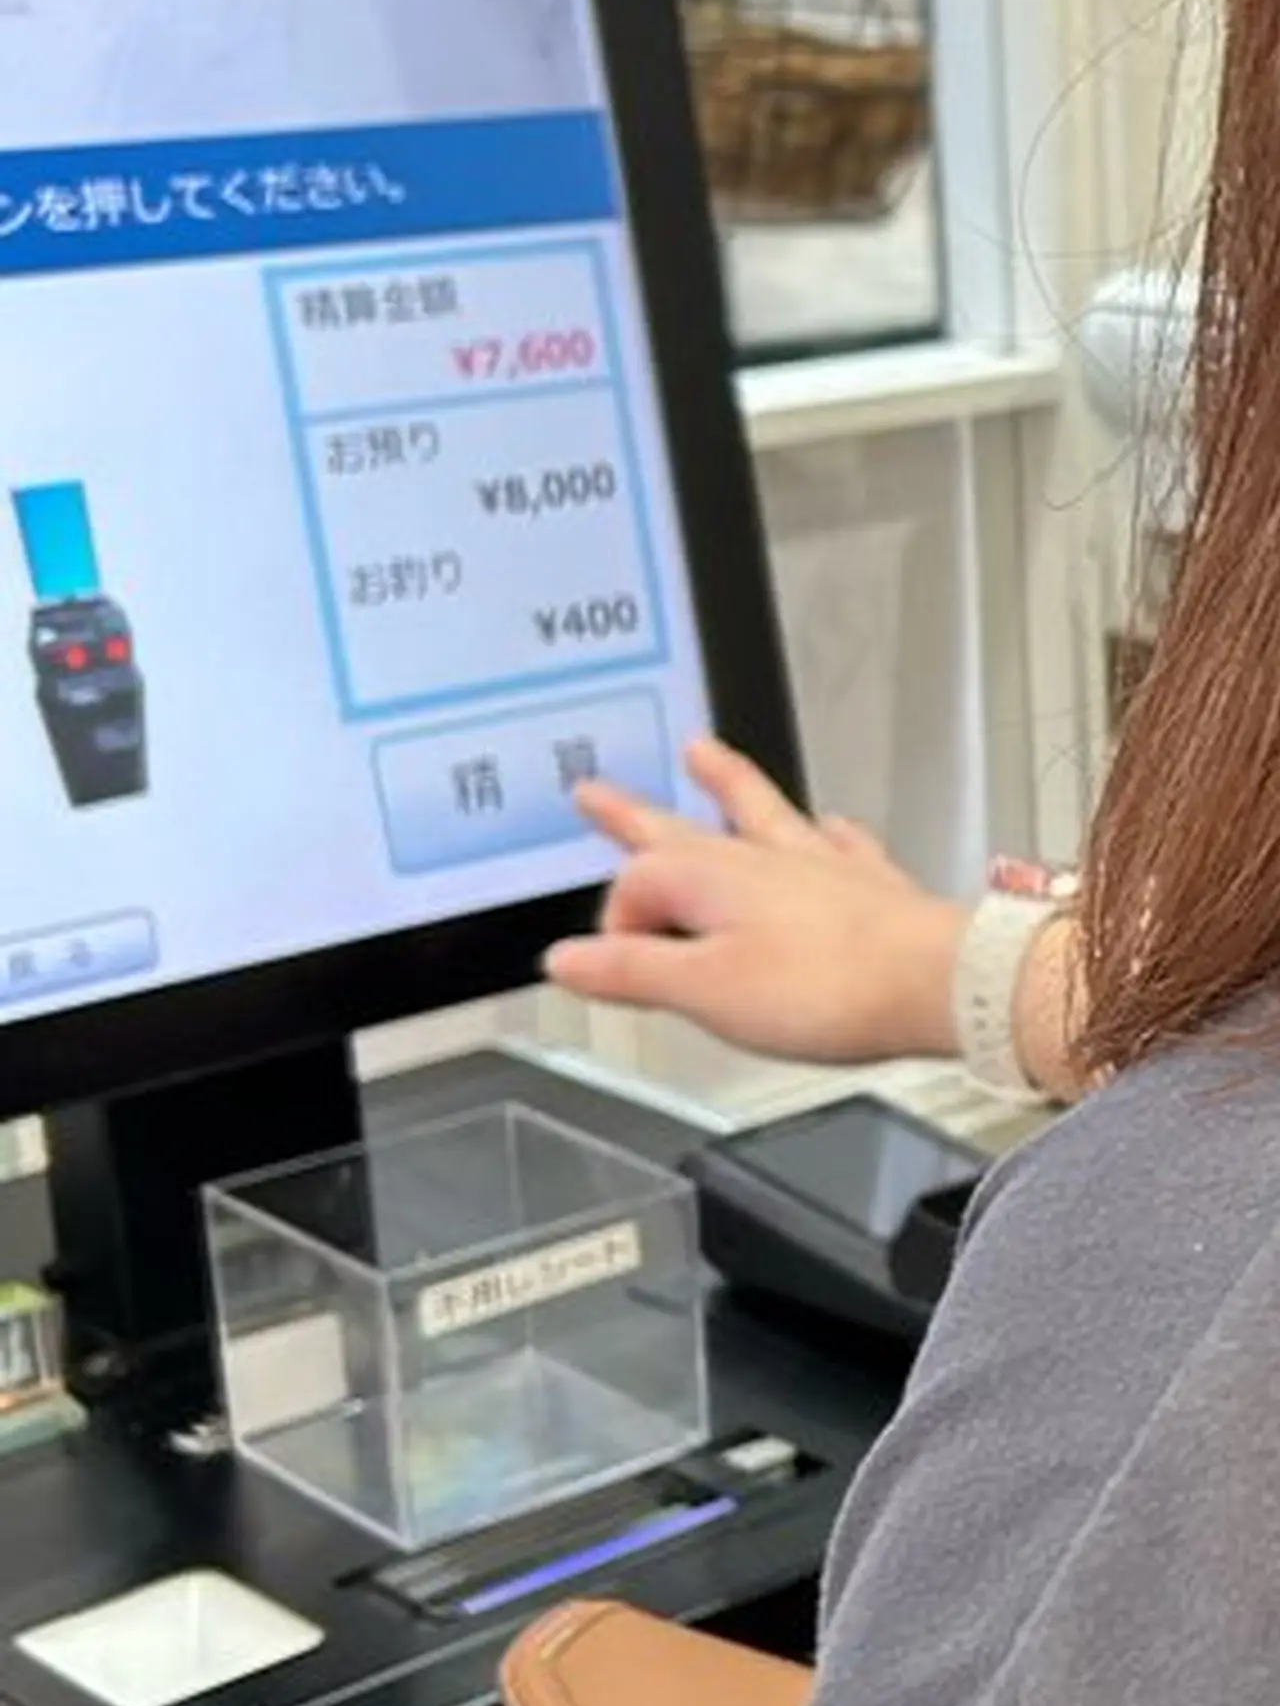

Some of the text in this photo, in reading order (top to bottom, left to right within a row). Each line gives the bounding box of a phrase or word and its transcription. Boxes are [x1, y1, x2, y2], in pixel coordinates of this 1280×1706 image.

[451, 329, 597, 380] ¥7,600
[326, 421, 441, 475] お預り
[473, 460, 618, 516] ¥8,000
[533, 595, 640, 645] ¥400
